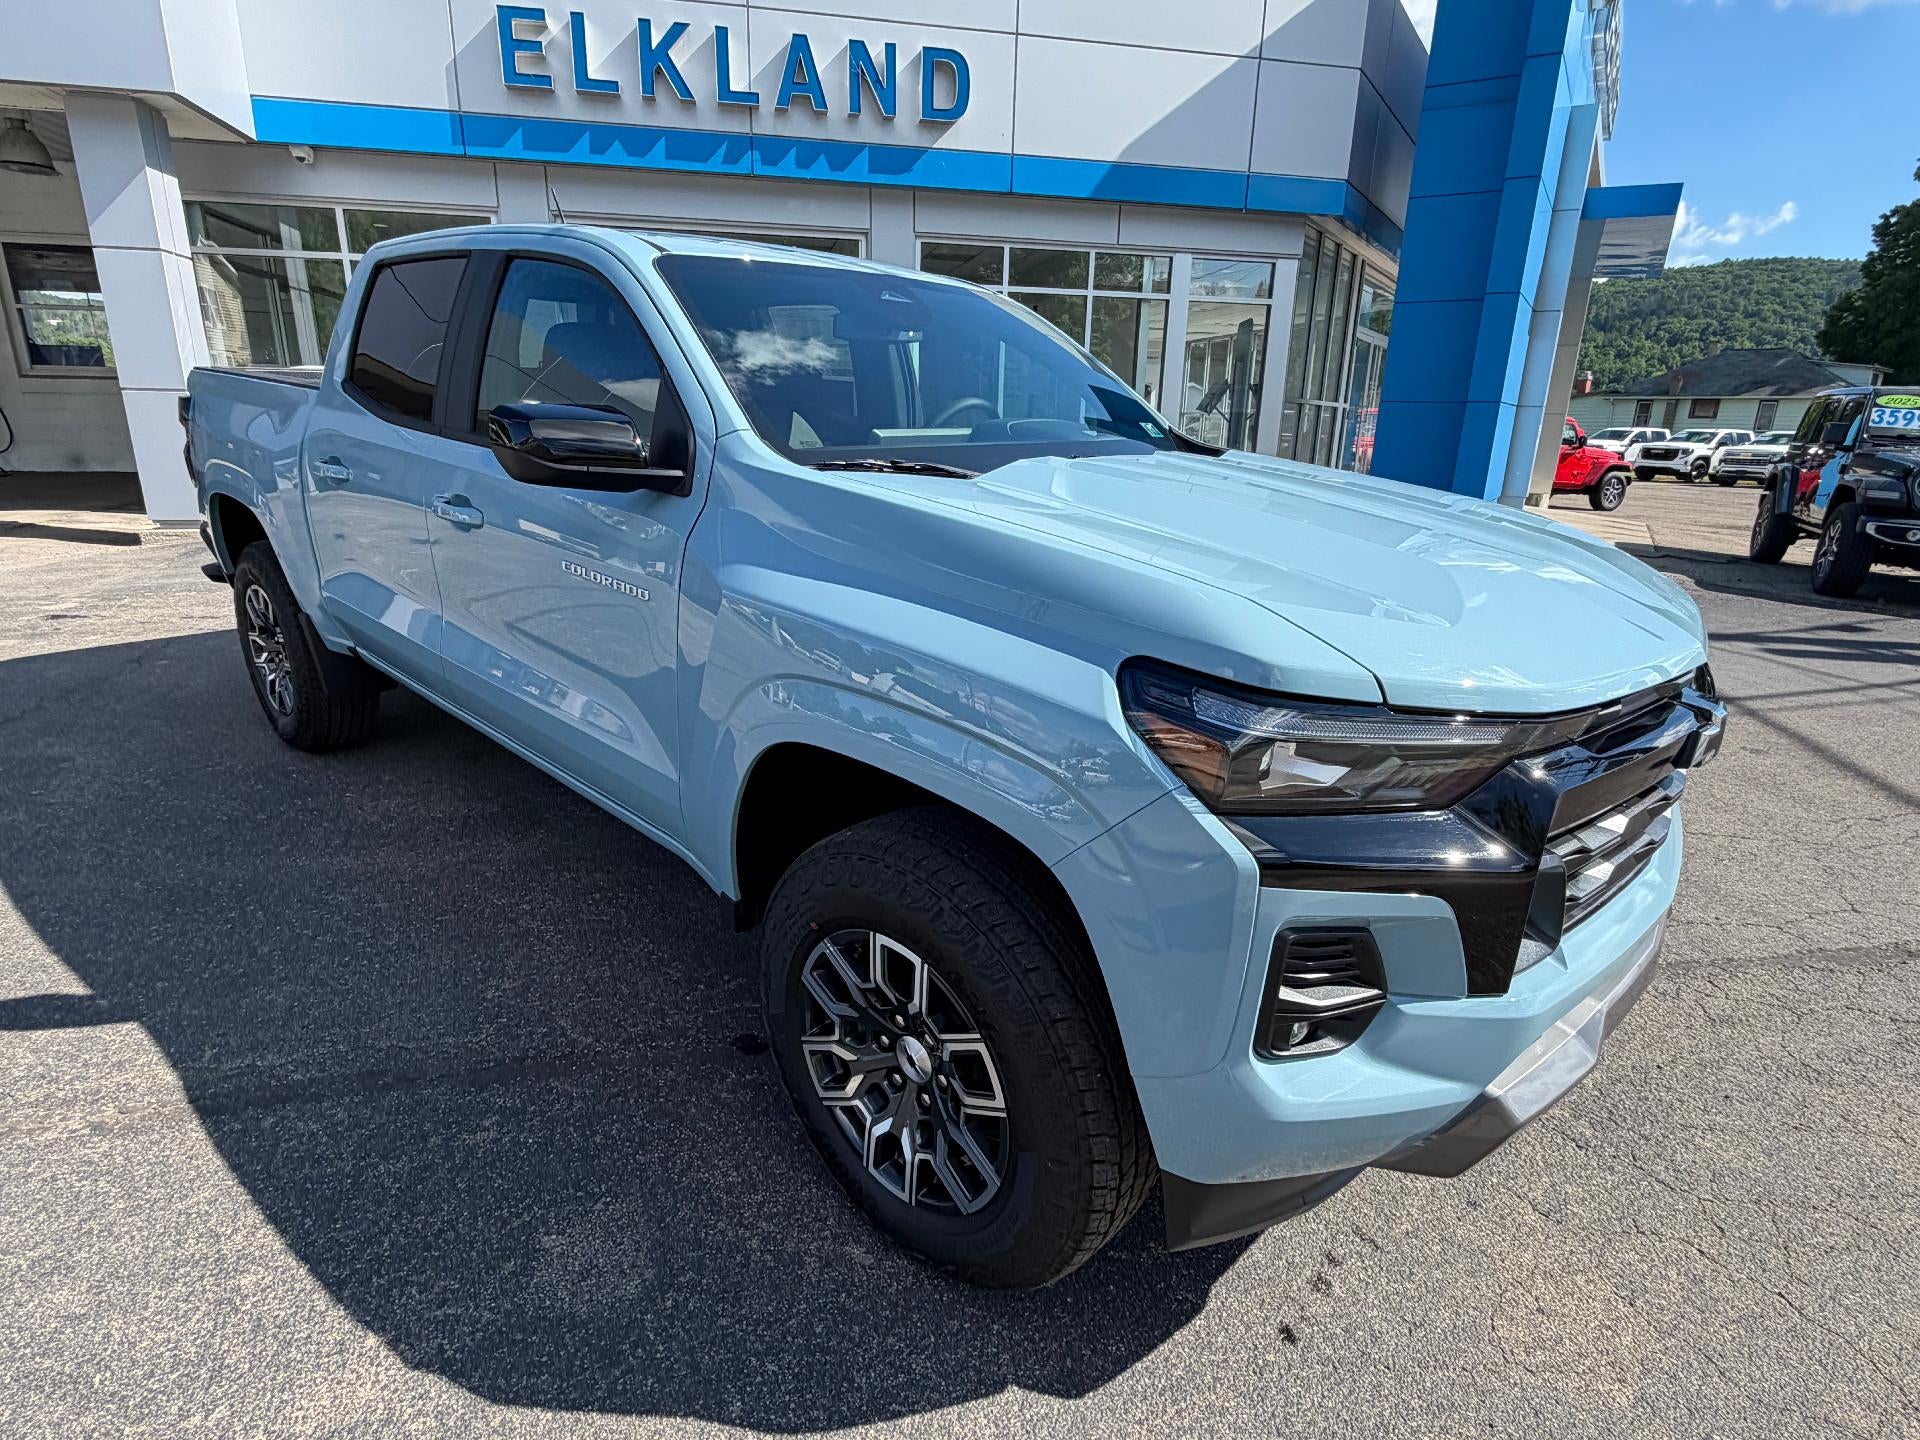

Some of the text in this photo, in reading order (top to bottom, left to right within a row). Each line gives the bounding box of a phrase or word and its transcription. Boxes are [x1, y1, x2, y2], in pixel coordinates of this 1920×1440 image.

[496, 4, 971, 121] ELKLAND
[1884, 397, 1919, 406] 2025
[1870, 408, 1920, 428] 359
[561, 560, 650, 601] COLORADO
